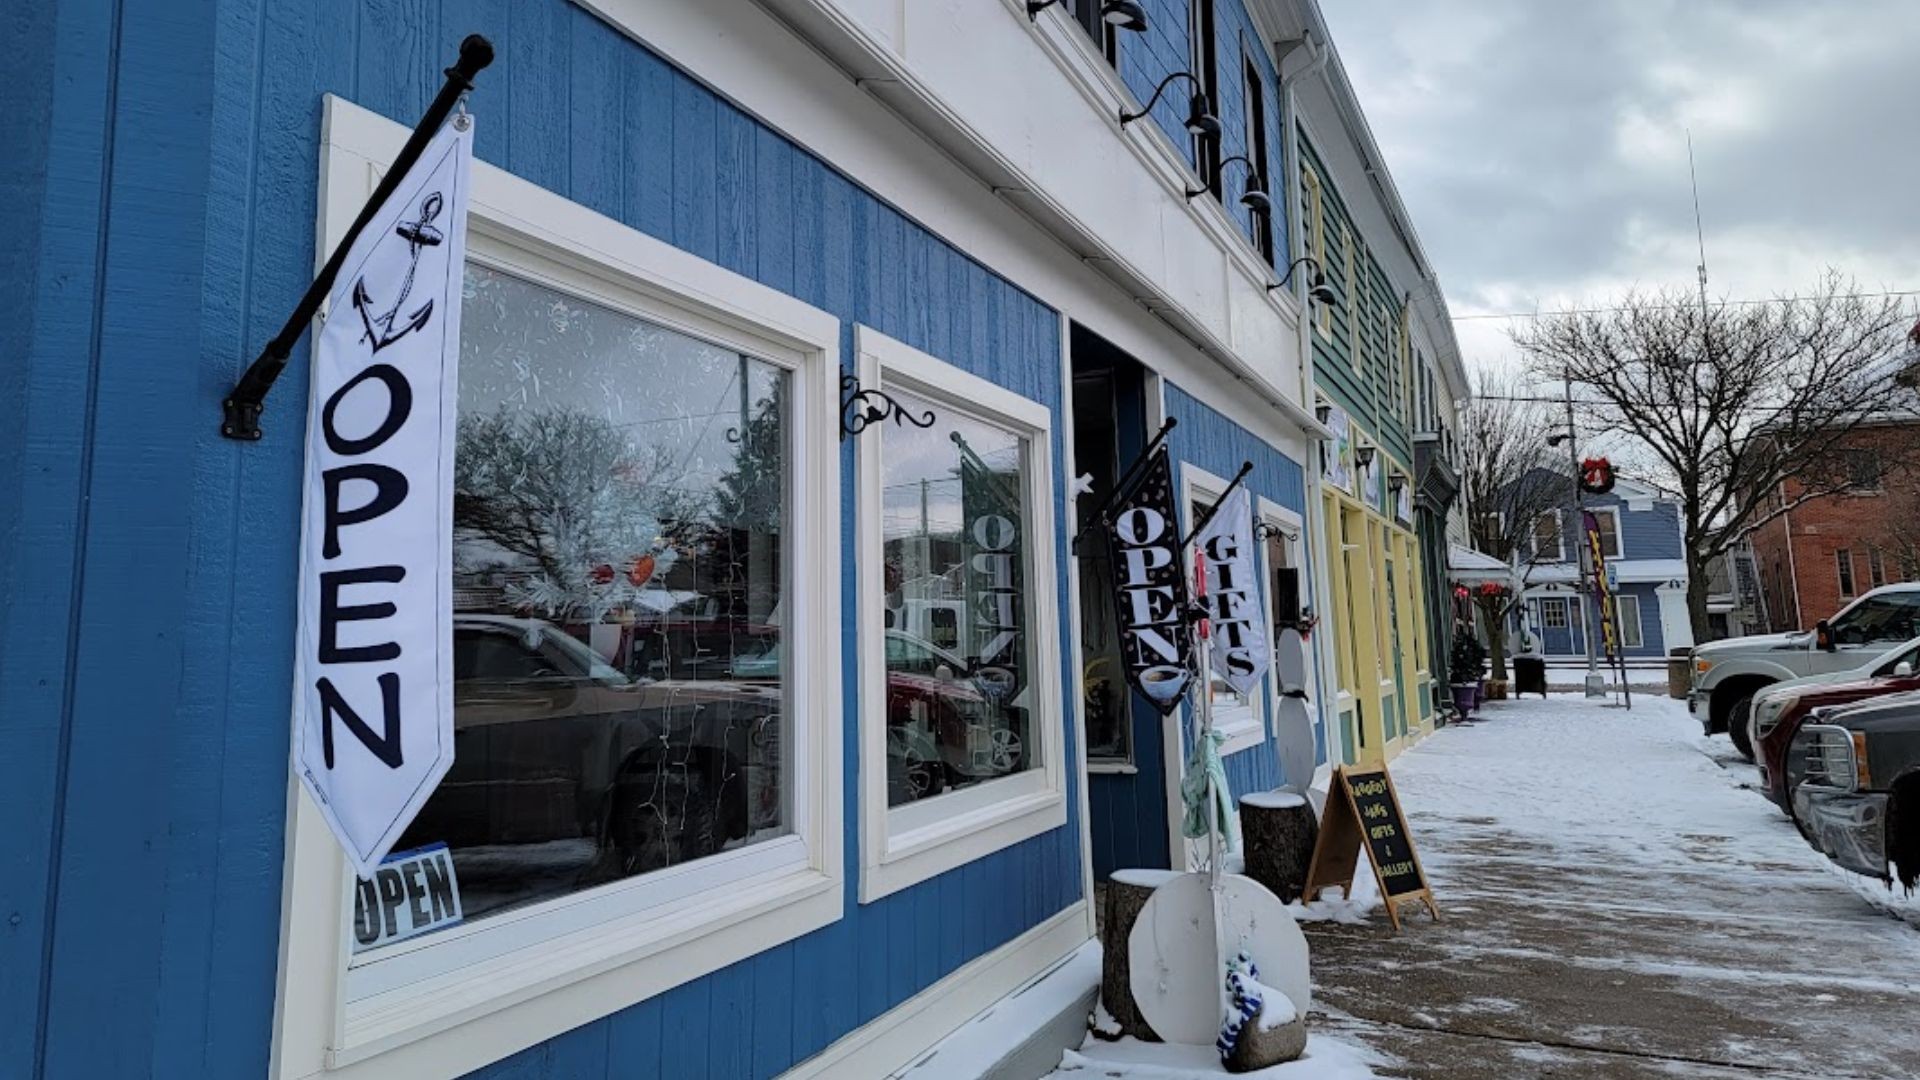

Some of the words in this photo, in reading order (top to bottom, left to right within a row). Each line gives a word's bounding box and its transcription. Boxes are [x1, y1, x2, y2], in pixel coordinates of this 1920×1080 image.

[316, 363, 413, 771] OPEN
[1116, 508, 1180, 667] OPEN
[1205, 534, 1255, 678] GIFTS
[354, 854, 456, 945] OPEN
[1371, 824, 1395, 839] GIFTS
